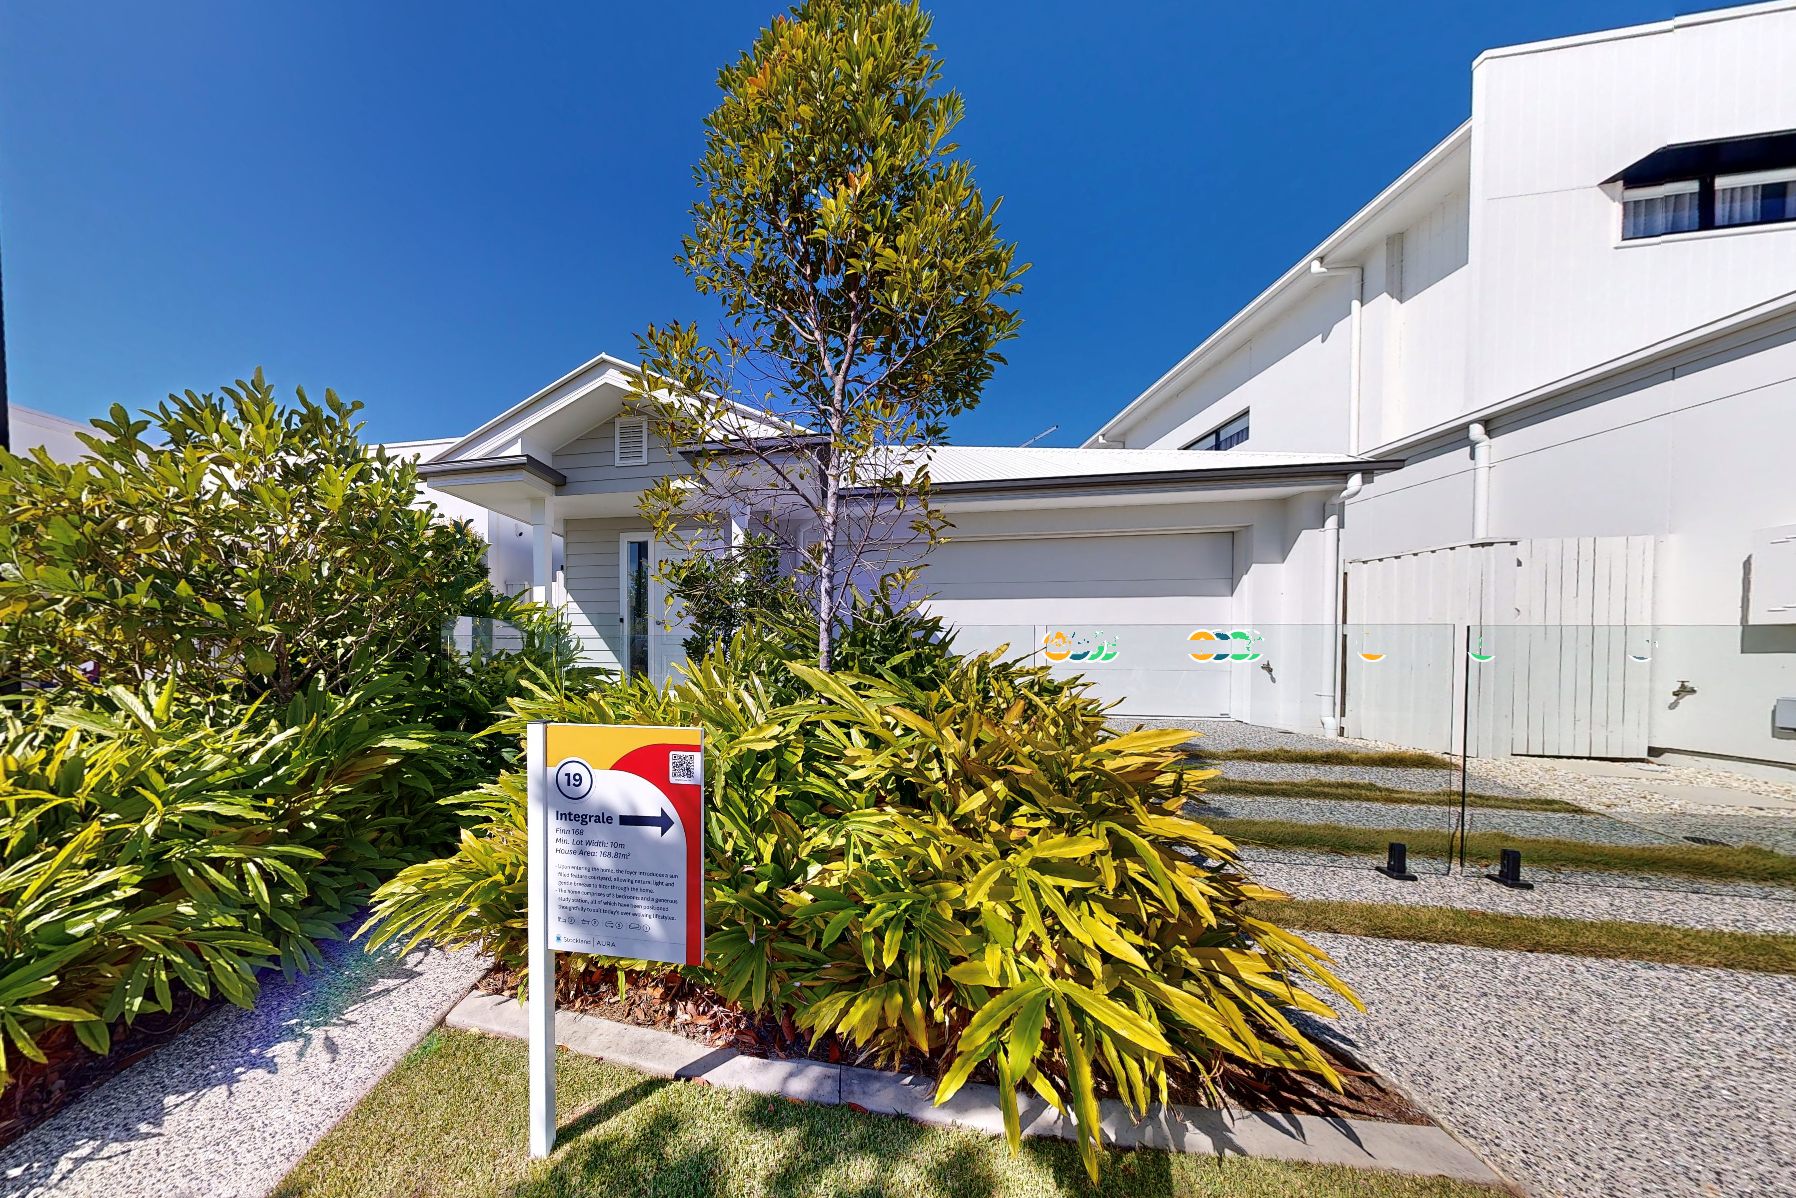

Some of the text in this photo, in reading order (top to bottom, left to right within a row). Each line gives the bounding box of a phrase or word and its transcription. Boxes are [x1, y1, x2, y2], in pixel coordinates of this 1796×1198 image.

[565, 772, 582, 787] 19
[556, 811, 614, 826] Integrale
[586, 840, 608, 848] Width:
[578, 849, 598, 857] Area:
